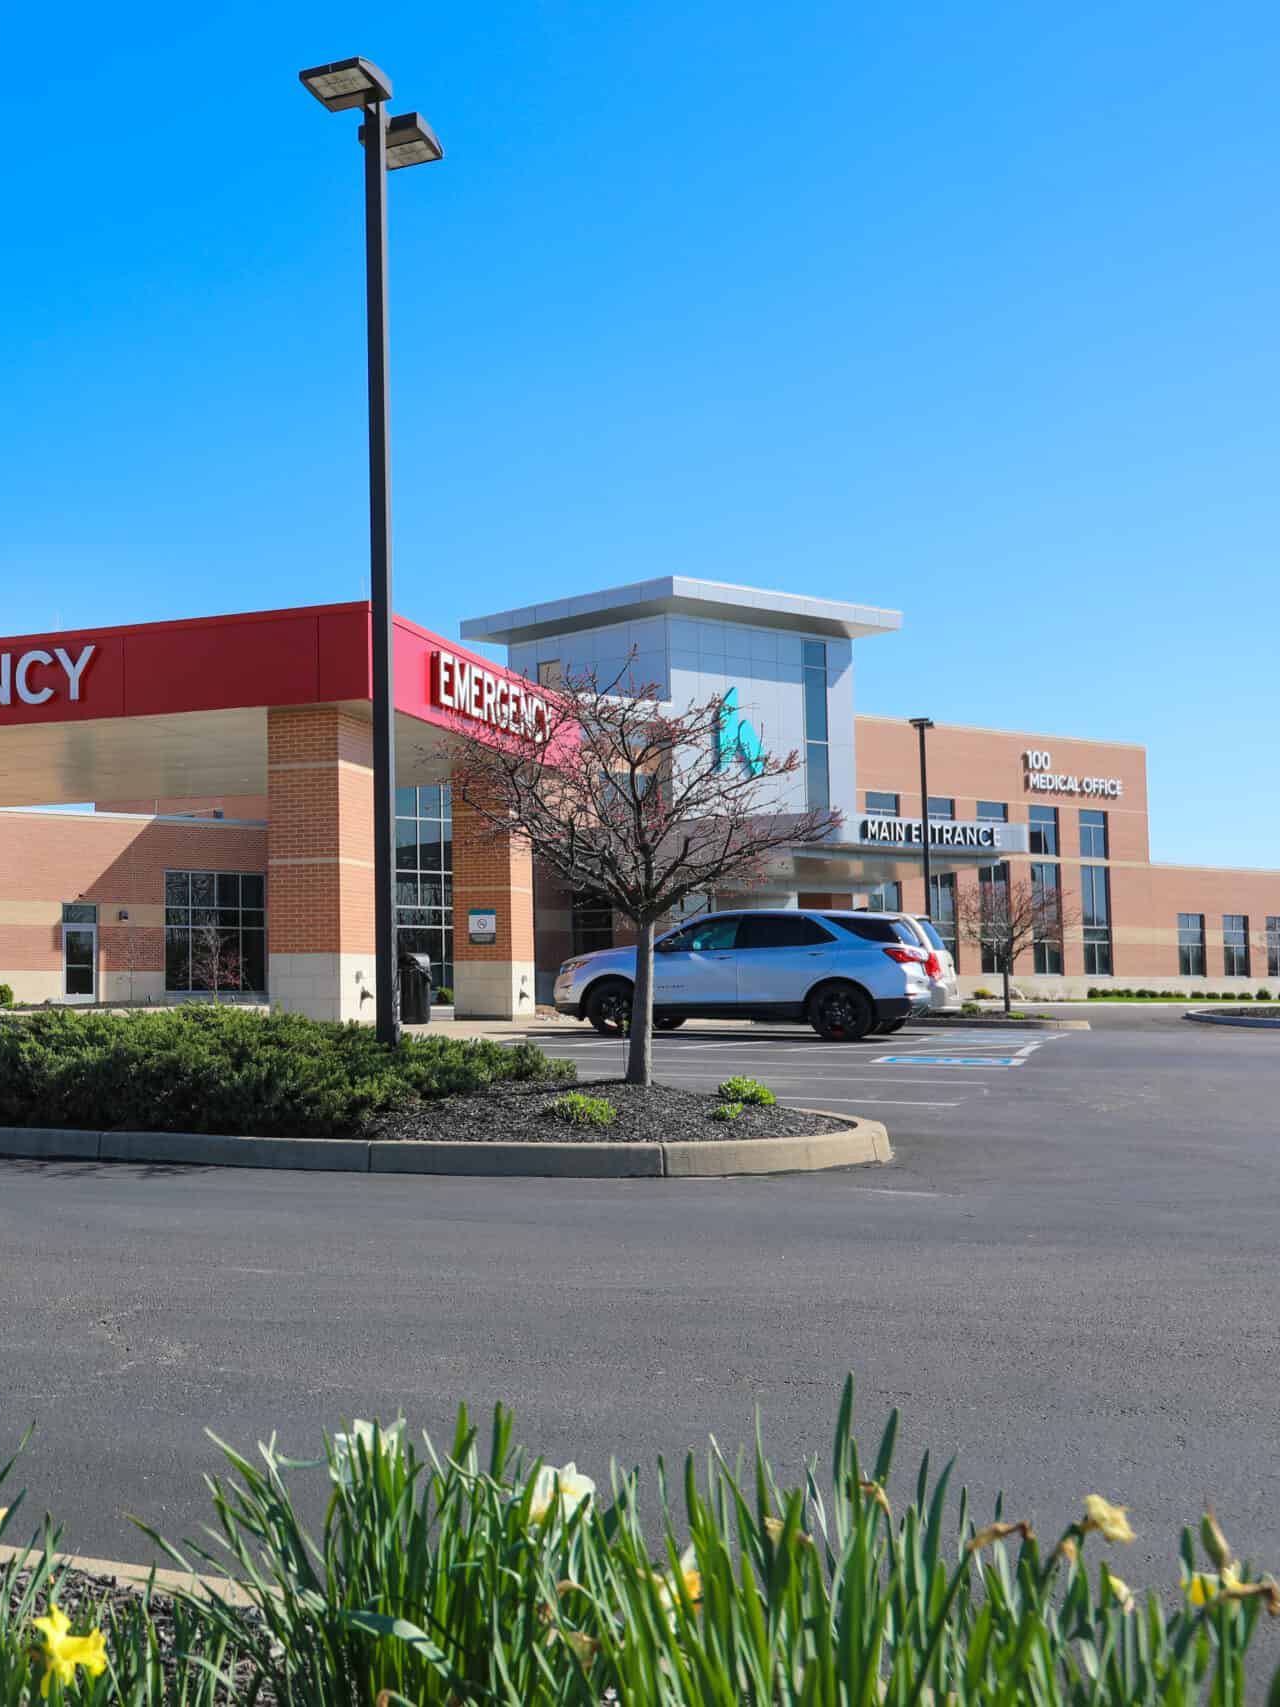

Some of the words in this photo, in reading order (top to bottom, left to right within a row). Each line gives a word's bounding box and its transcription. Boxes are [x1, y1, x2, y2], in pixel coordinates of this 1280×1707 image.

[439, 651, 553, 743] EMERGENCY
[1026, 750, 1051, 770] 100
[1029, 773, 1080, 792] MEDICAL
[1083, 777, 1122, 795] OFFICE
[867, 820, 906, 841] MAIN
